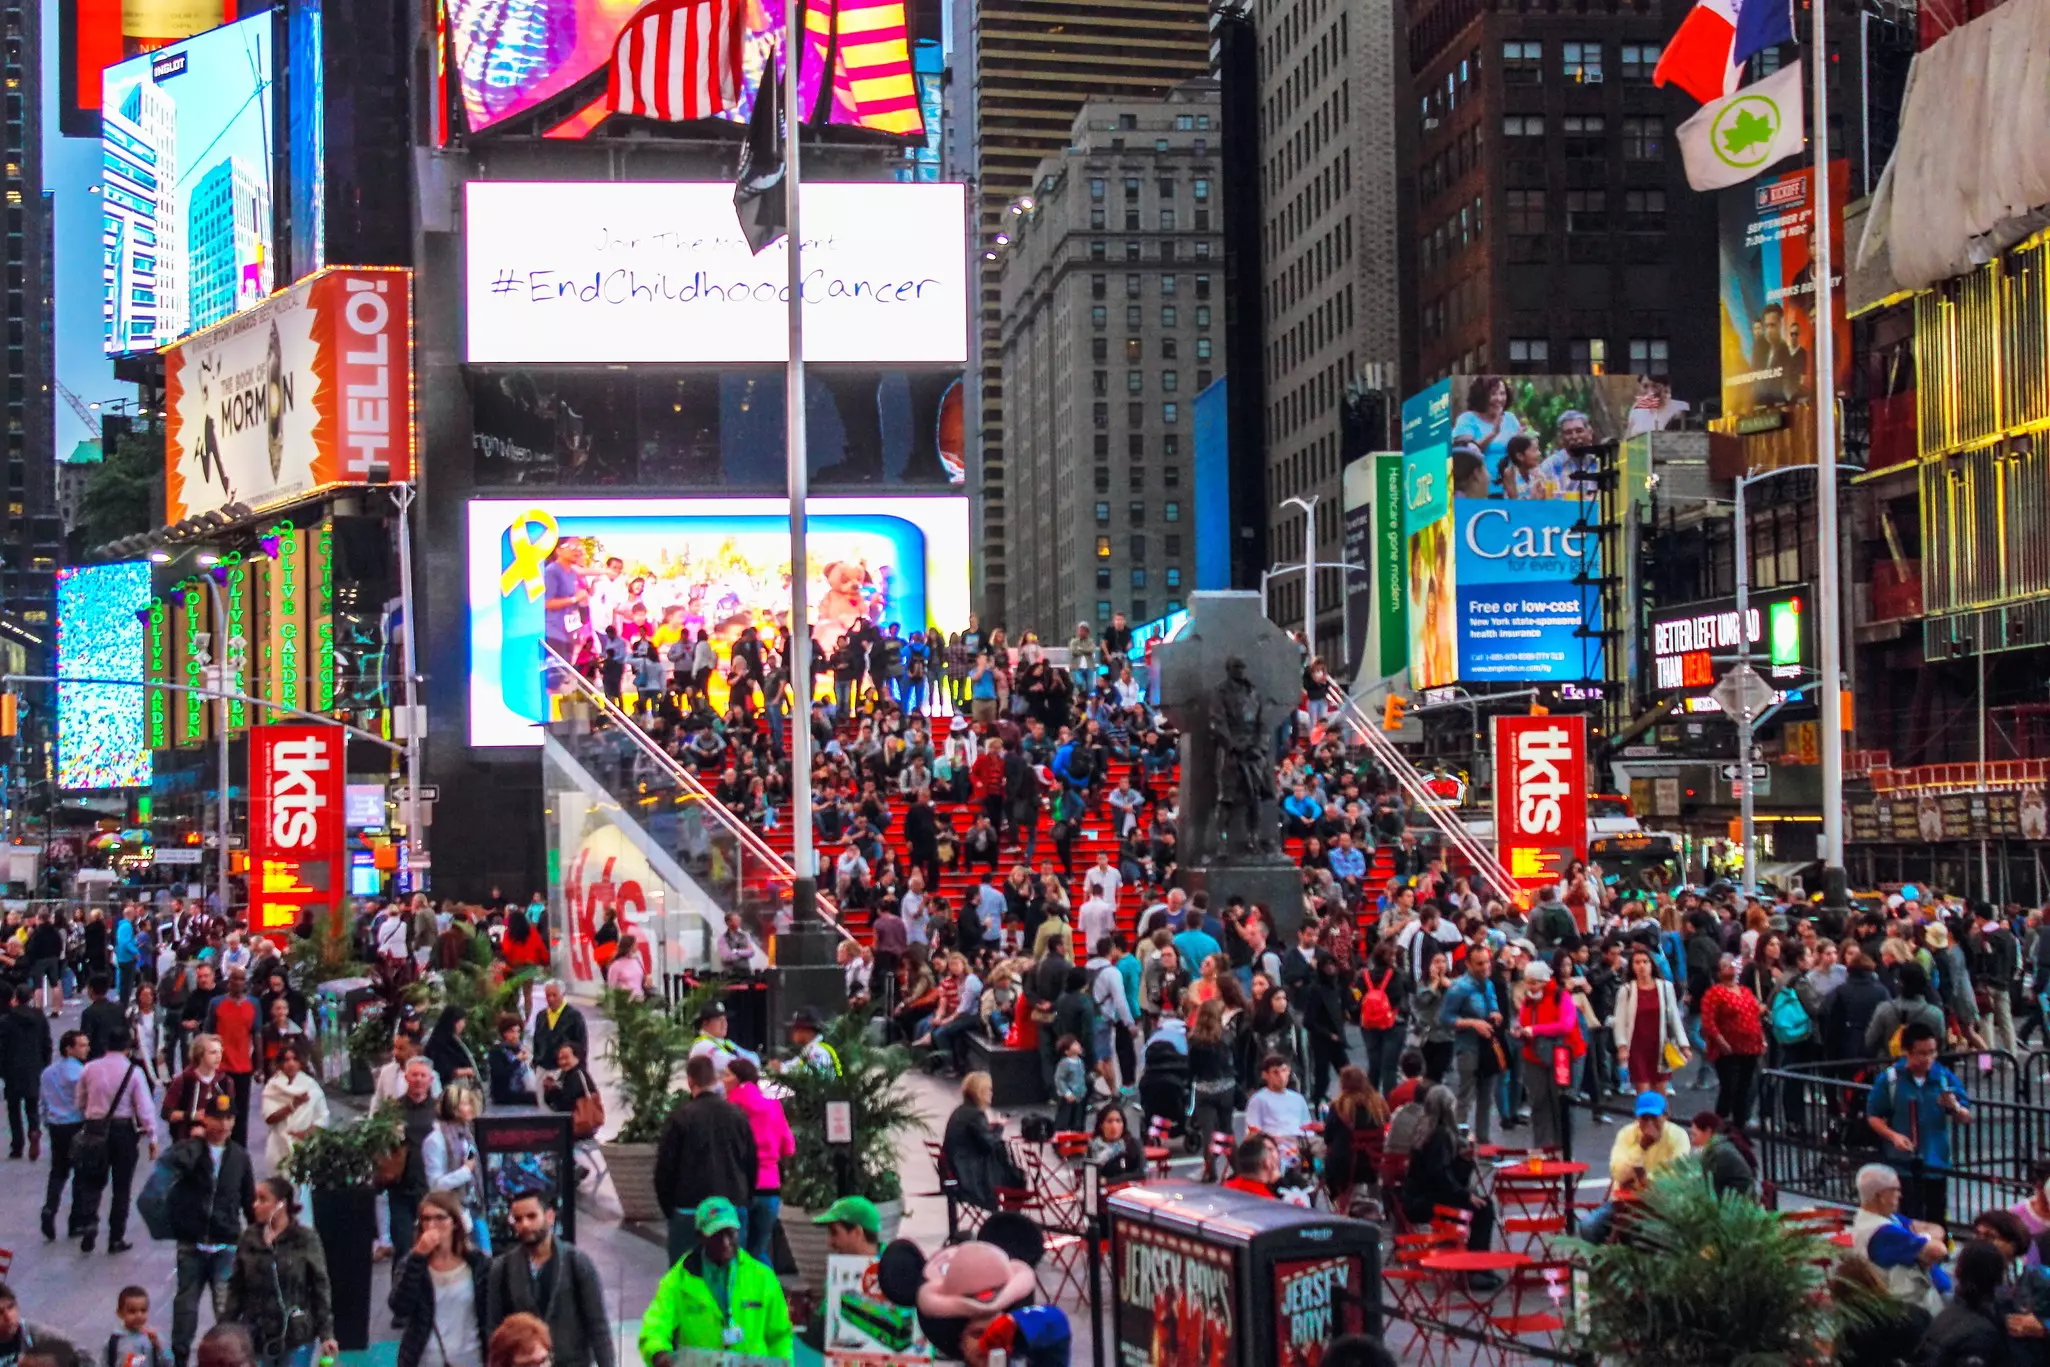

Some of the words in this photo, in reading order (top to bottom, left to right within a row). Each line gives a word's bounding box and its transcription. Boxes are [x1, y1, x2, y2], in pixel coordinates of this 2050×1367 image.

[153, 57, 186, 77] INGLOT
[1770, 183, 1801, 201] KICKOFF
[653, 233, 703, 251] The
[1746, 213, 1798, 235] SEPTEMBER
[221, 378, 233, 396] THE
[235, 369, 255, 391] BOOK
[256, 362, 267, 380] OF
[345, 278, 390, 473] HELLO!
[1388, 467, 1400, 530] Healthcare
[1387, 531, 1400, 561] gone
[1465, 508, 1586, 558] Care
[280, 539, 297, 615] OLIVE
[1508, 560, 1526, 572] for
[1530, 560, 1566, 575] every
[185, 591, 200, 655] OLIVE
[228, 569, 244, 638] OLIVE
[1469, 600, 1500, 613] Free
[1503, 602, 1519, 613] or
[1521, 599, 1580, 613] low-cost
[1470, 618, 1489, 627] New
[1490, 617, 1511, 627] York
[150, 611, 164, 671] OLIVE
[1470, 630, 1498, 638] health
[1499, 629, 1542, 638] insurance
[1655, 618, 1693, 655] BETTER
[1693, 614, 1717, 650] LEFT
[1717, 608, 1760, 647] UNRAD
[280, 624, 297, 713] GARDEN
[1656, 655, 1683, 689] THAN
[272, 735, 330, 849] tkts
[1518, 725, 1573, 835] tkts
[1119, 1239, 1183, 1313] JERSEY
